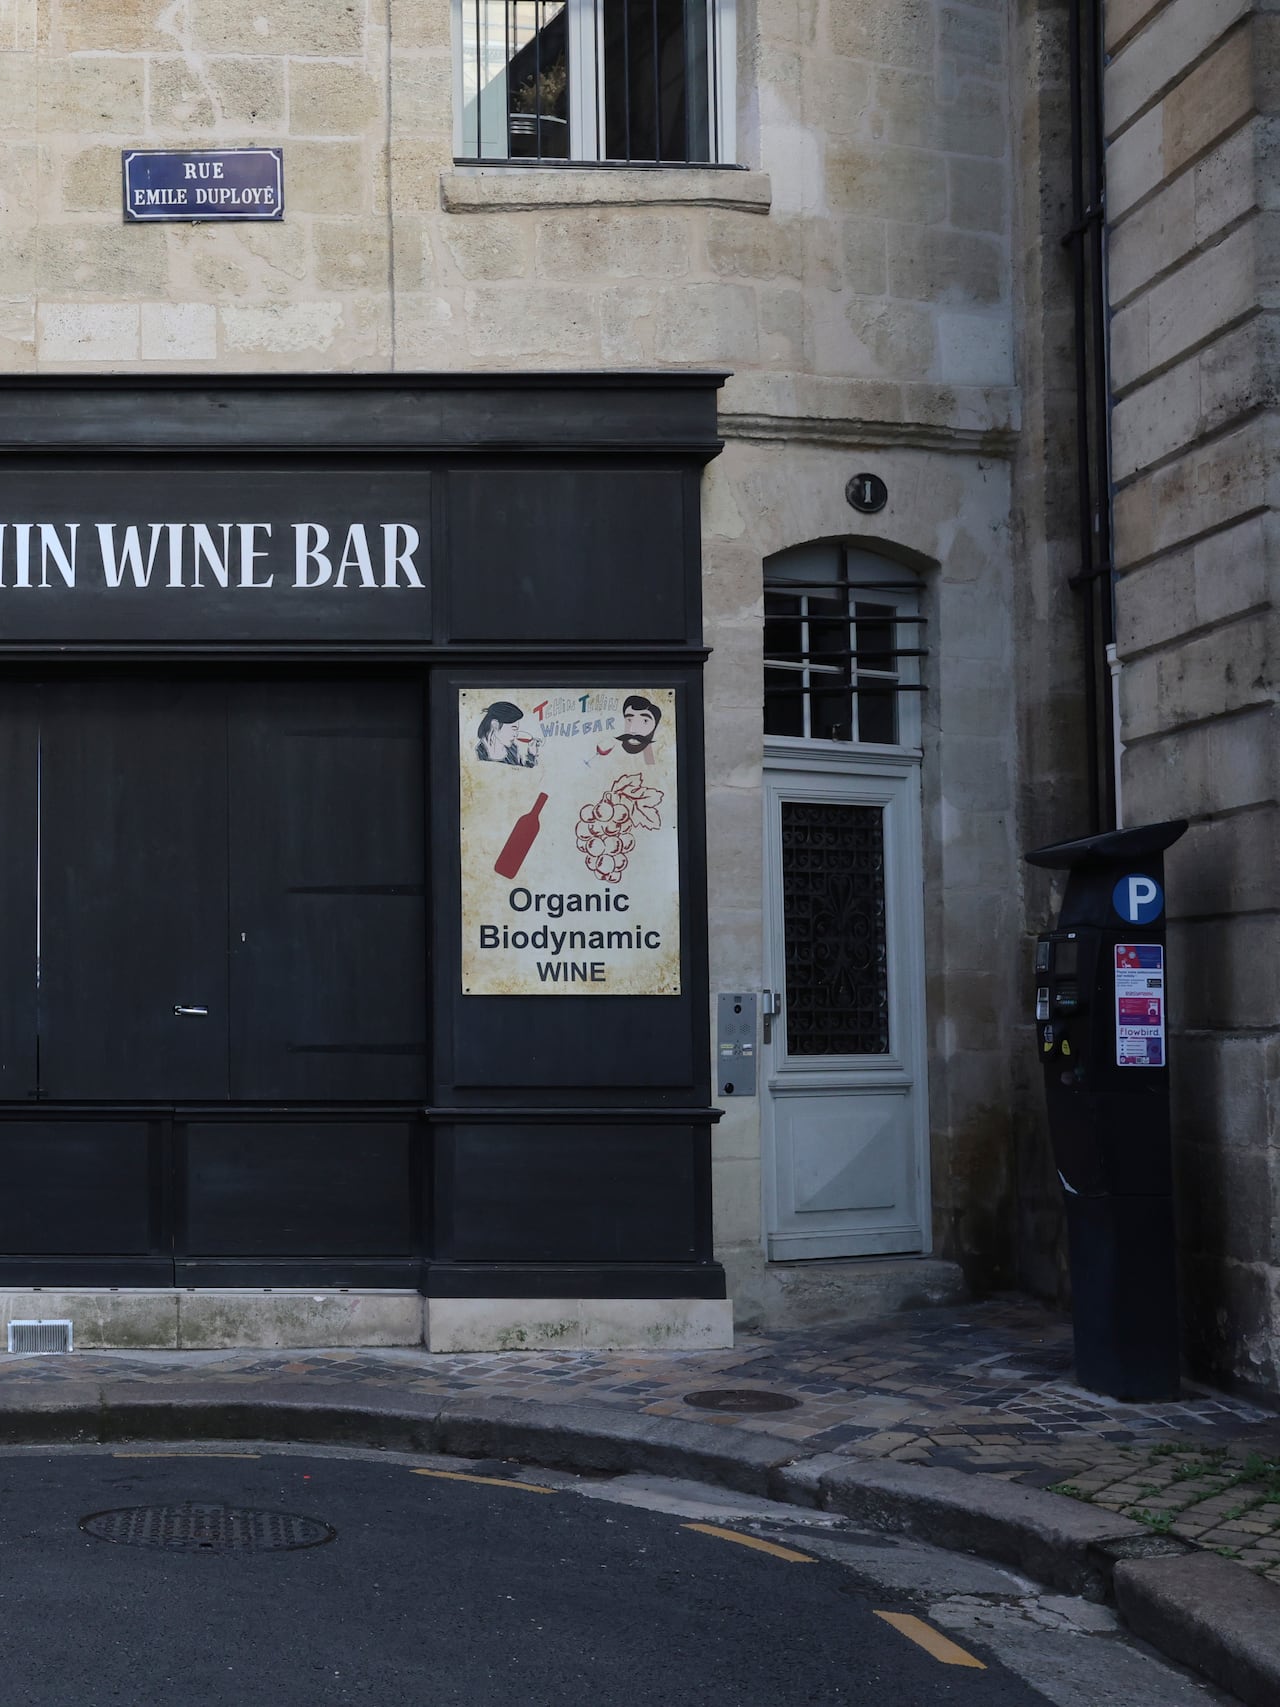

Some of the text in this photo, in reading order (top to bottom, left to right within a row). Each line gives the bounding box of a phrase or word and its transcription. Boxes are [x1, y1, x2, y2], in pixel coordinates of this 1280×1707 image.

[184, 162, 224, 179] RUE
[134, 186, 275, 206] EMILE DUPLOYÉ
[95, 522, 274, 589] WINE
[291, 522, 426, 589] BAR
[509, 887, 630, 918] Organic
[1128, 876, 1157, 921] P
[480, 924, 661, 956] Biodynamic
[536, 962, 606, 982] WINE
